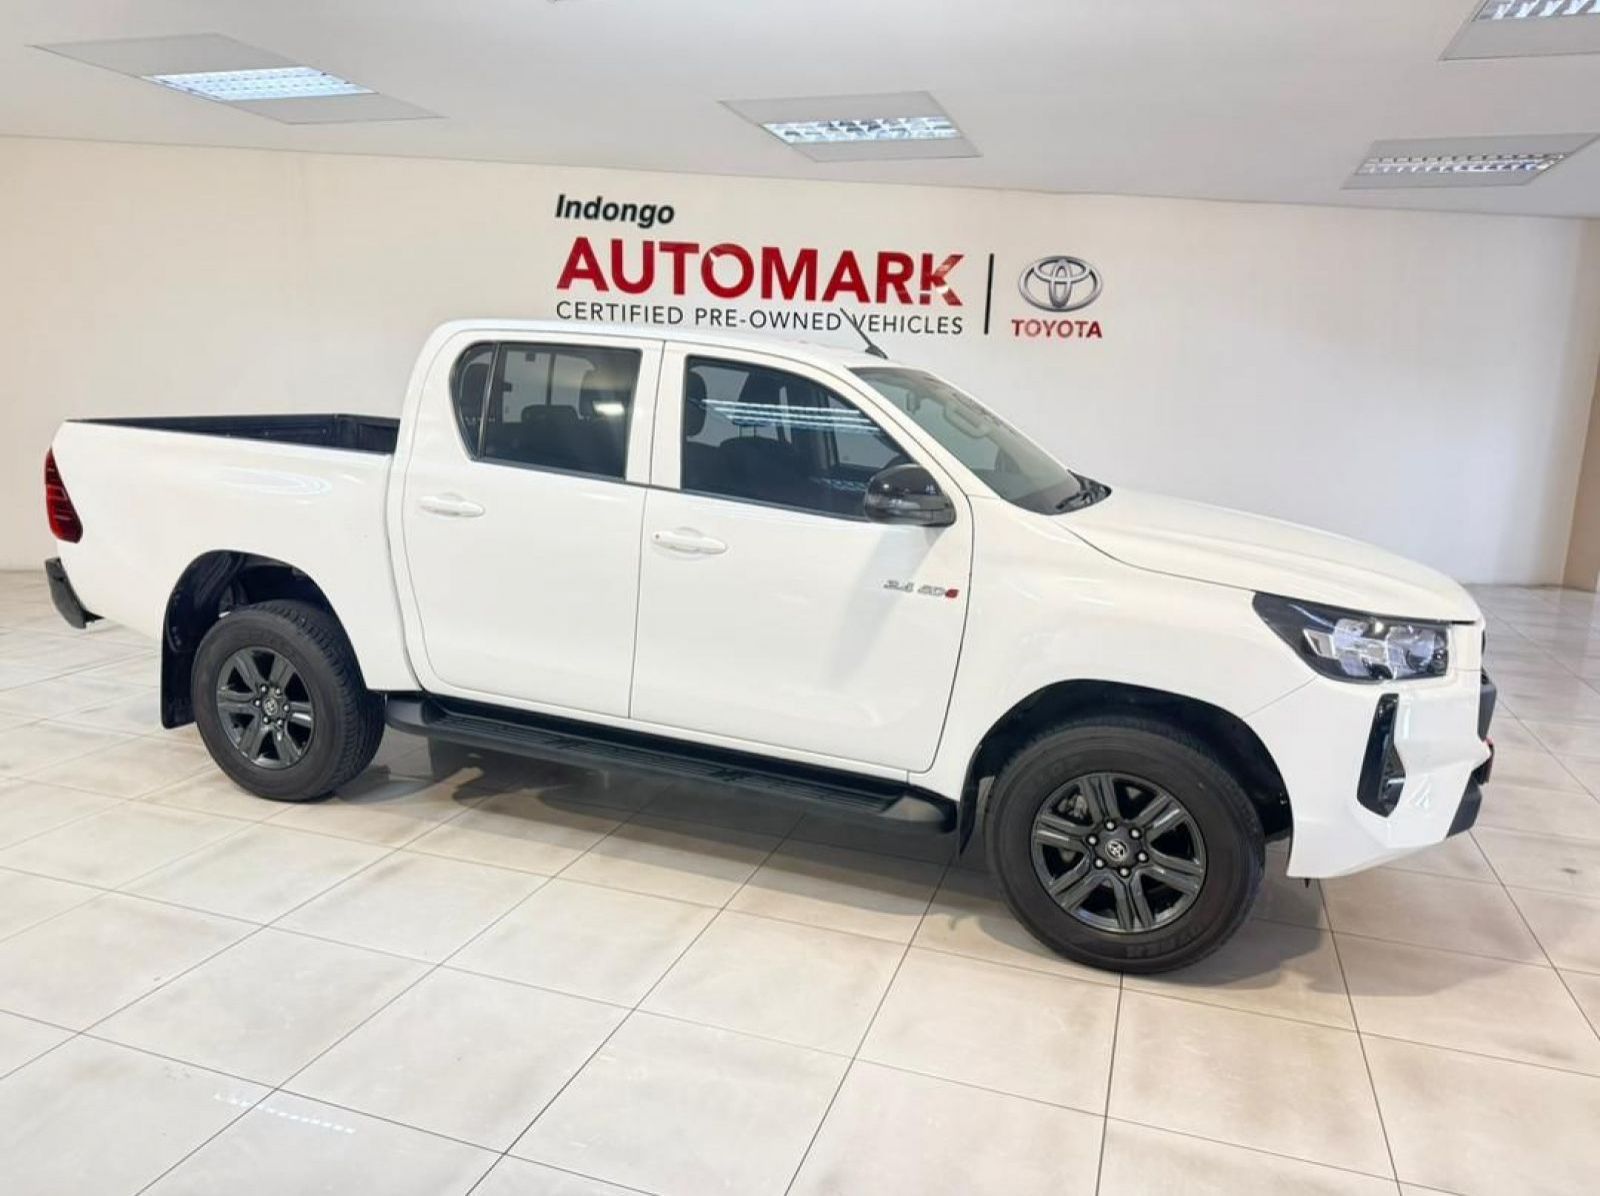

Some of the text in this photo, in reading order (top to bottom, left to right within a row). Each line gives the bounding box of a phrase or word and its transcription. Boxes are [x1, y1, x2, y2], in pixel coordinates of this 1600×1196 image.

[555, 194, 675, 229] Indongo
[556, 236, 965, 306] AUTOMARK
[556, 301, 964, 335] CERTIFIED PRE-OWNED VEHICLES
[1011, 319, 1103, 338] TOYOTA
